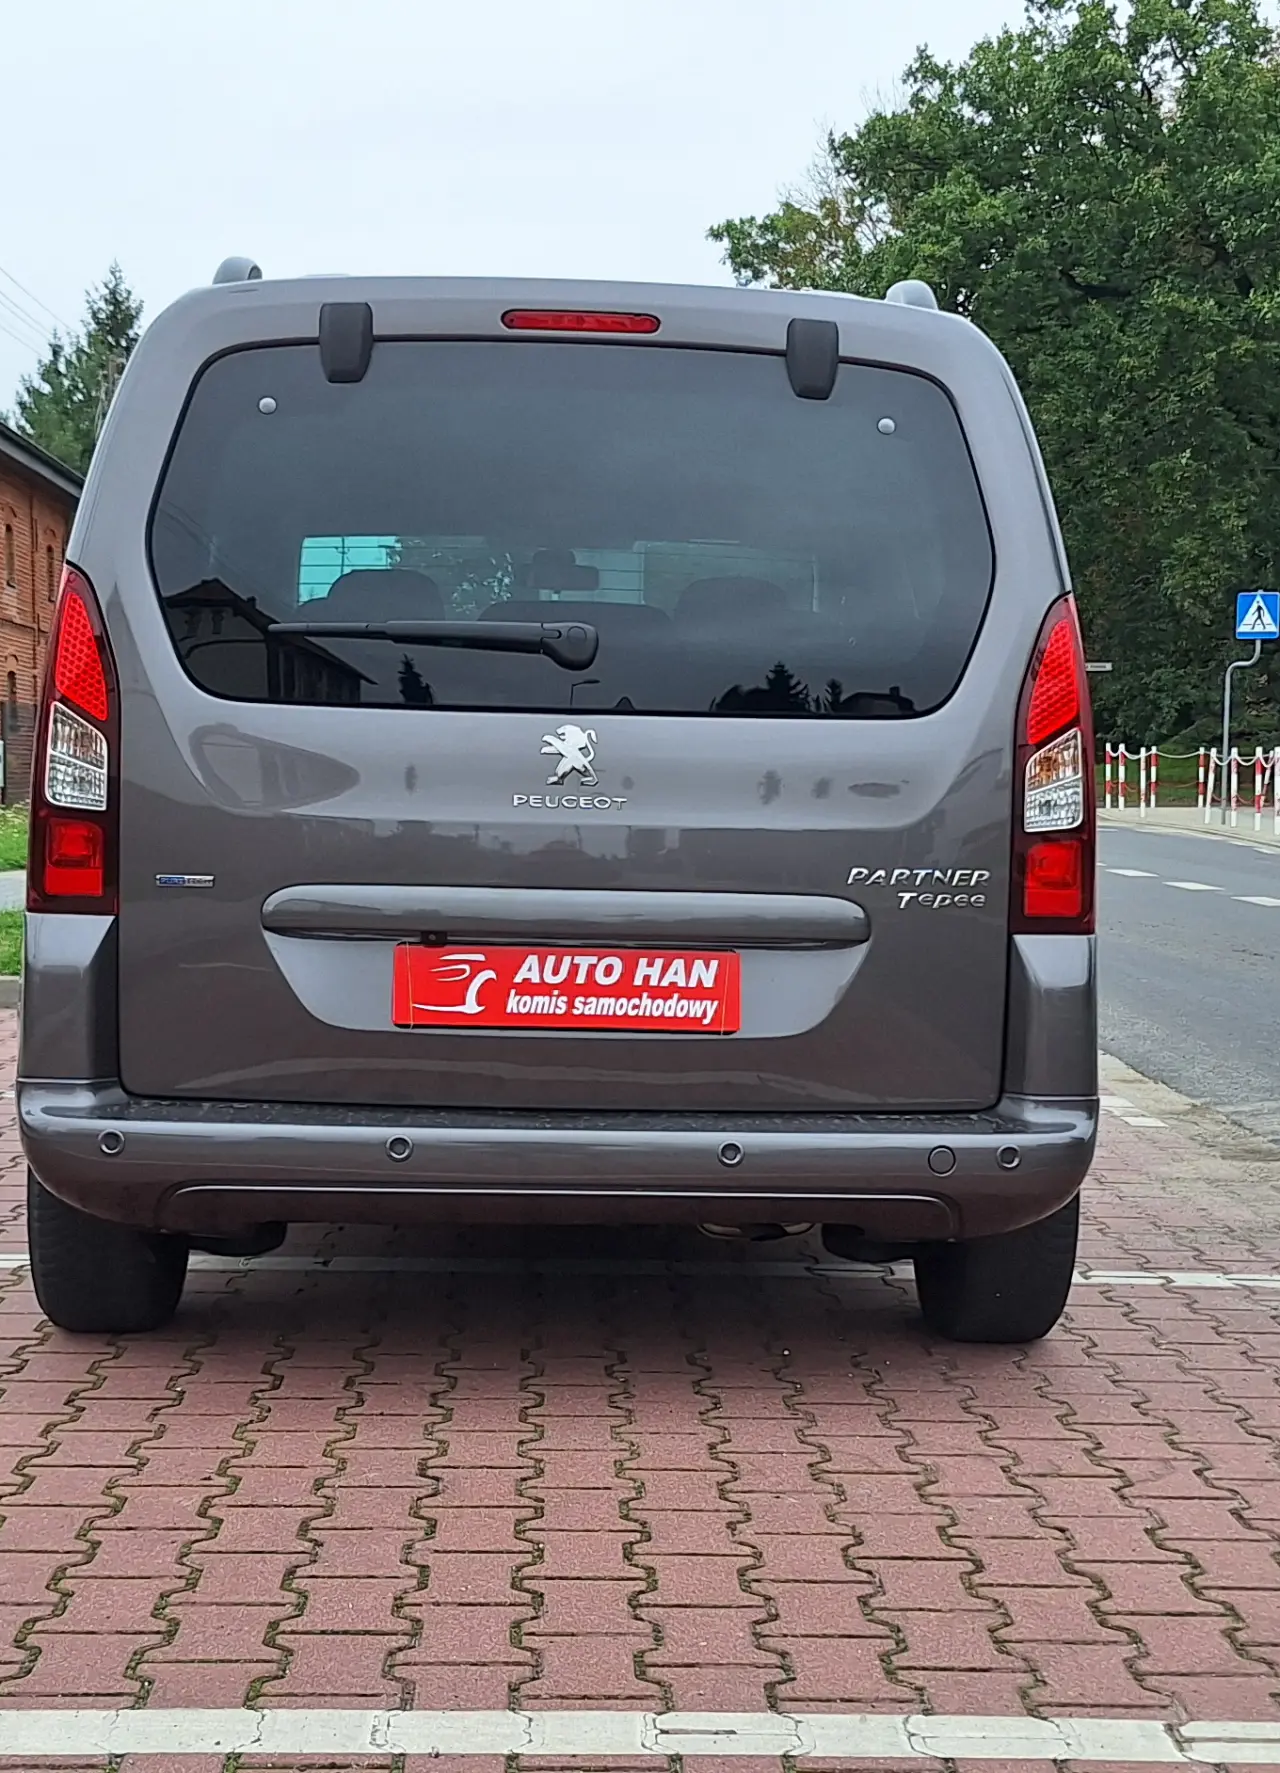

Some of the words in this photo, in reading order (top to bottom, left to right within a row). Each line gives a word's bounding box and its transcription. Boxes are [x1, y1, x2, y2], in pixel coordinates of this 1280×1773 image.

[512, 795, 628, 810] PEUGEOT
[846, 867, 991, 887] PARTNER
[897, 892, 986, 909] Tepee
[513, 953, 621, 986] AUTO
[633, 956, 719, 989] HAN
[506, 989, 567, 1016] komis
[572, 990, 718, 1025] samochodowy
